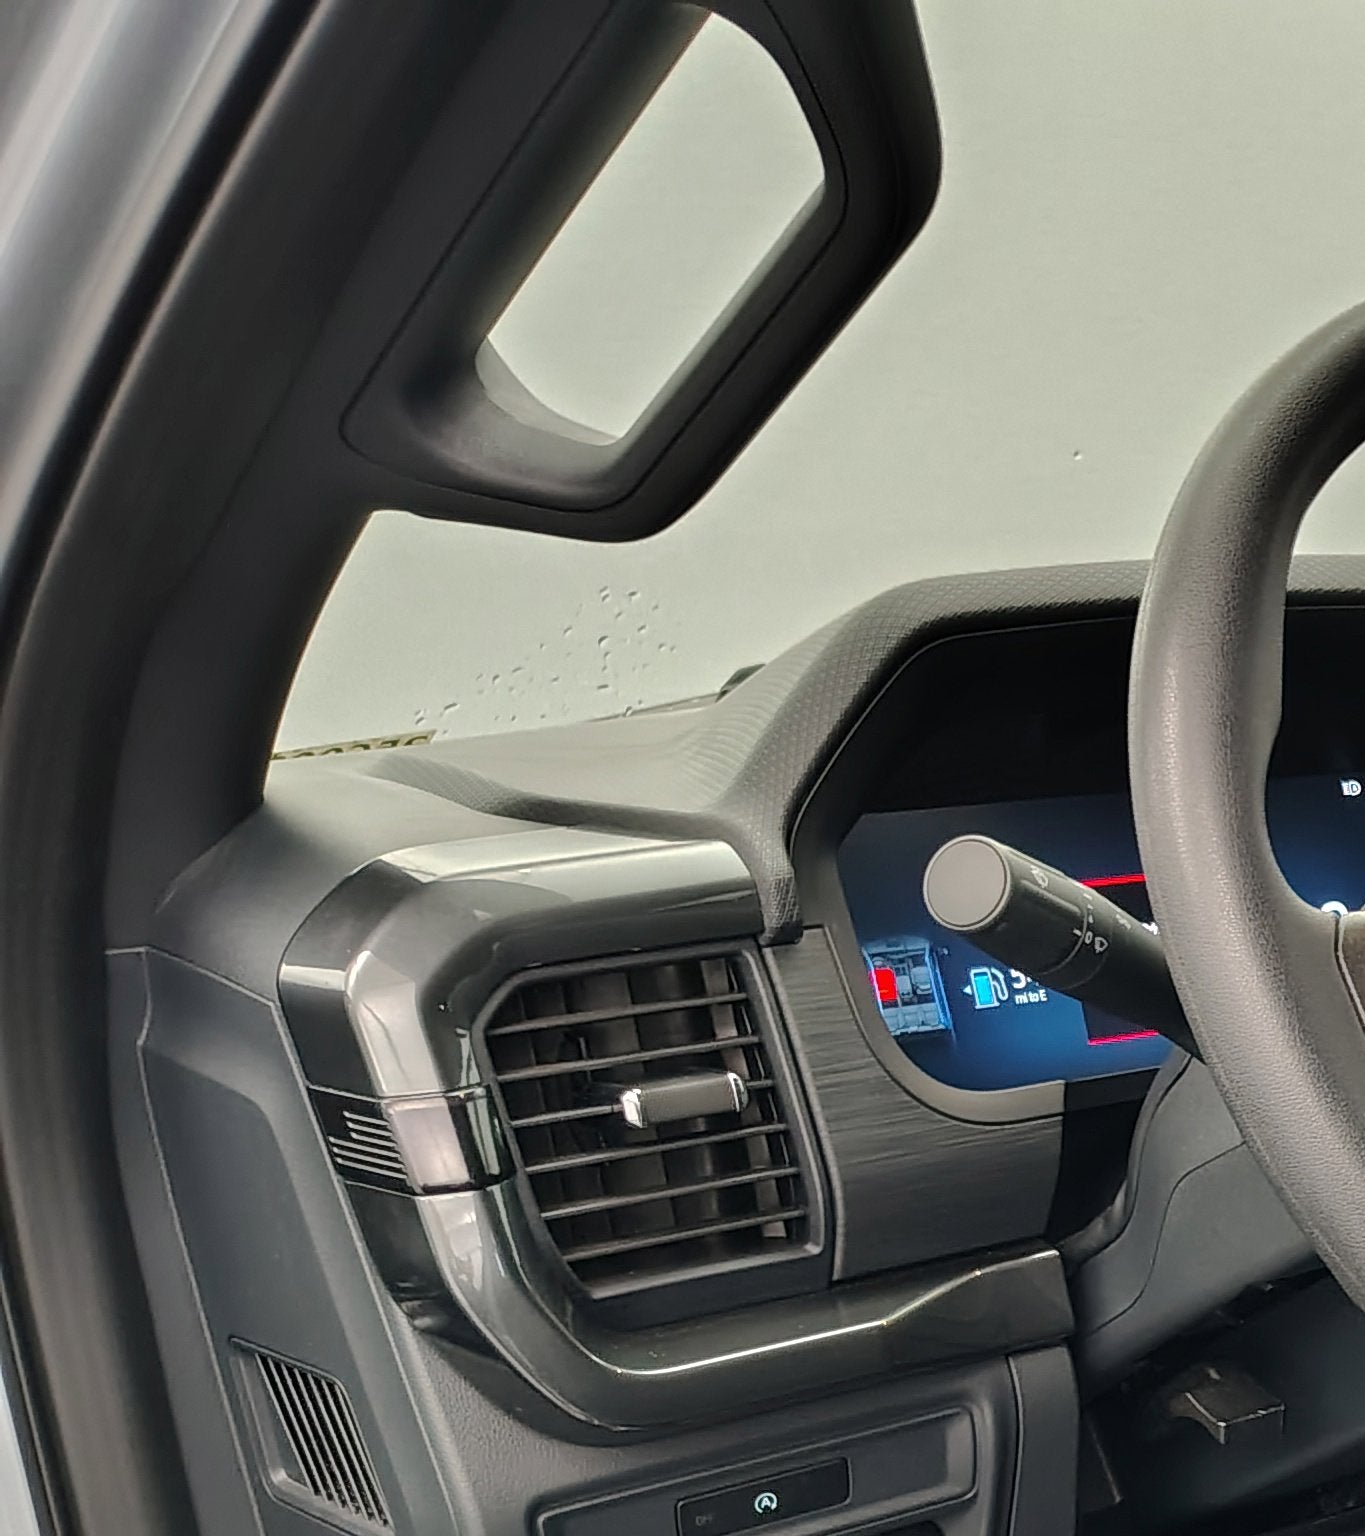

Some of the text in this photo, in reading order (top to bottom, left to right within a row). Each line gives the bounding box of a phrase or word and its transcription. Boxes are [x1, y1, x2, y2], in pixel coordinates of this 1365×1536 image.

[1015, 989, 1048, 1005] mi to E
